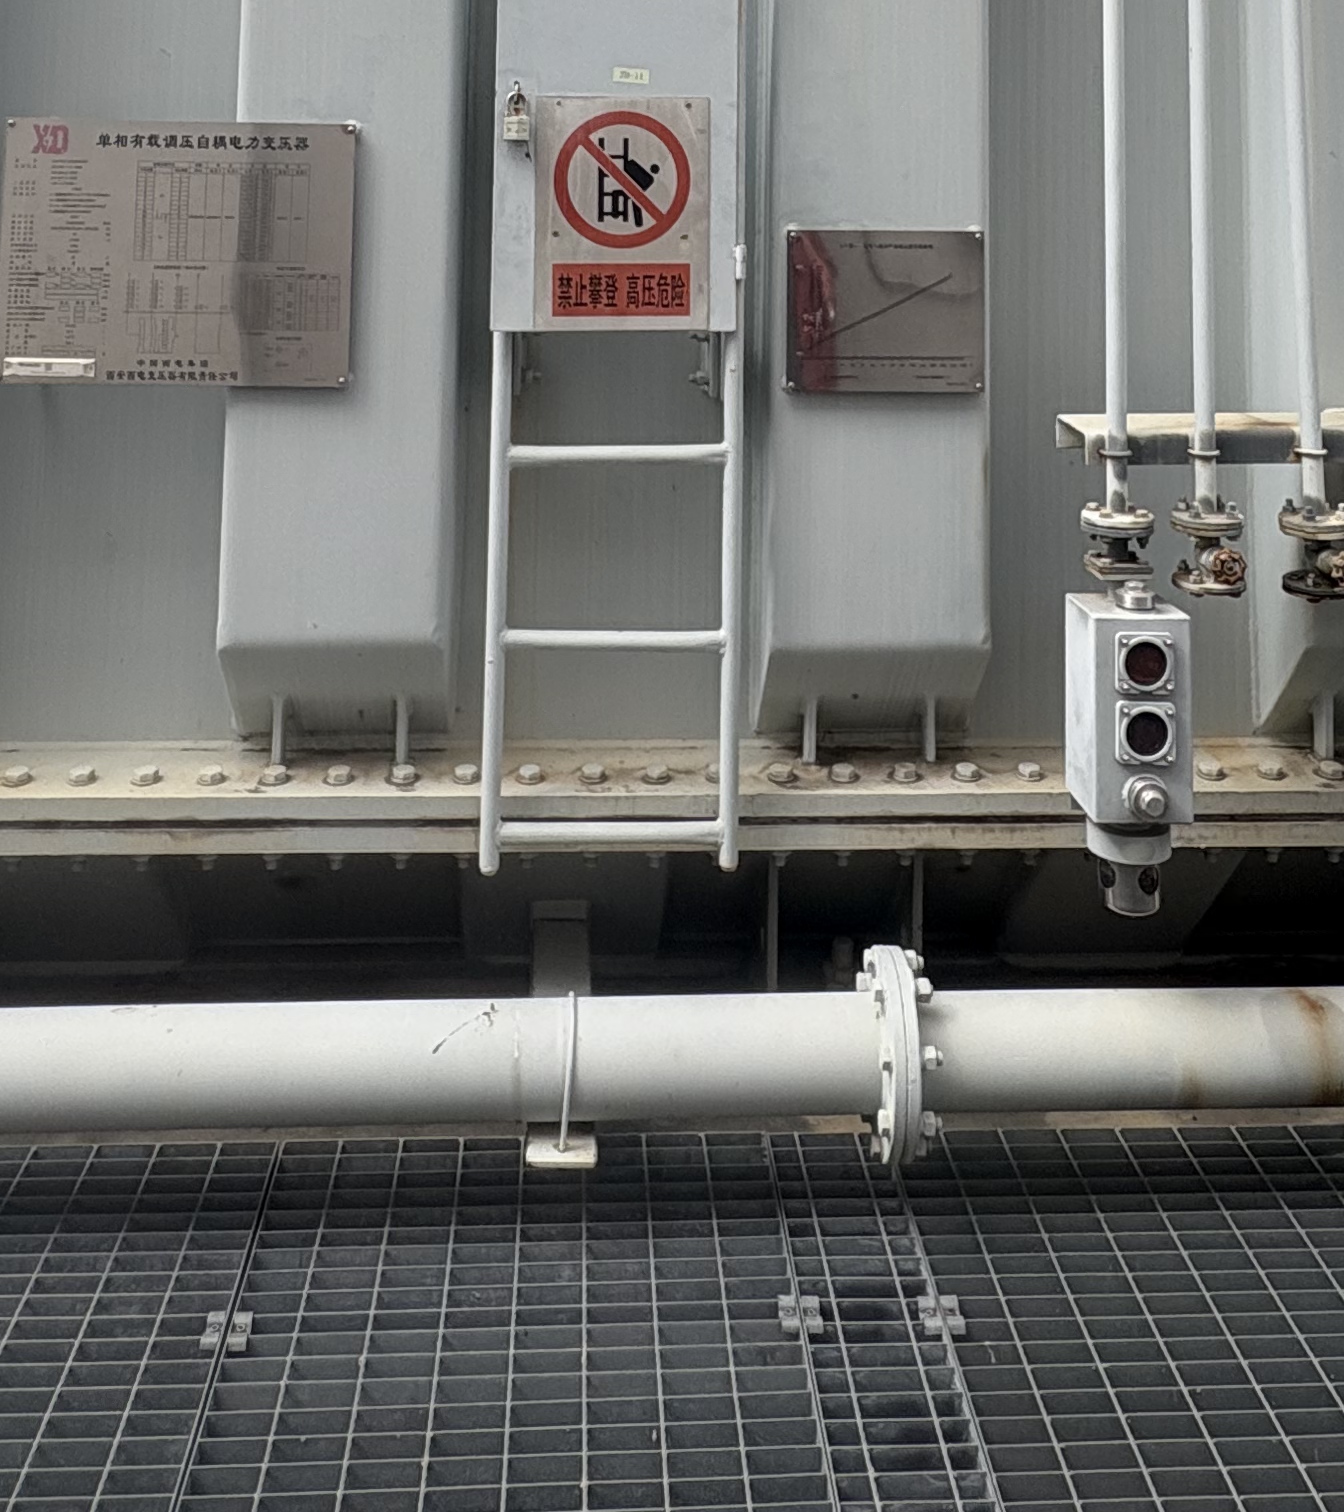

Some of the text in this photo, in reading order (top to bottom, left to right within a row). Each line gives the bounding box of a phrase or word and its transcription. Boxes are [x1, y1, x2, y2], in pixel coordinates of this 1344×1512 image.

[557, 272, 686, 309] 禁止攀登 高压危险
